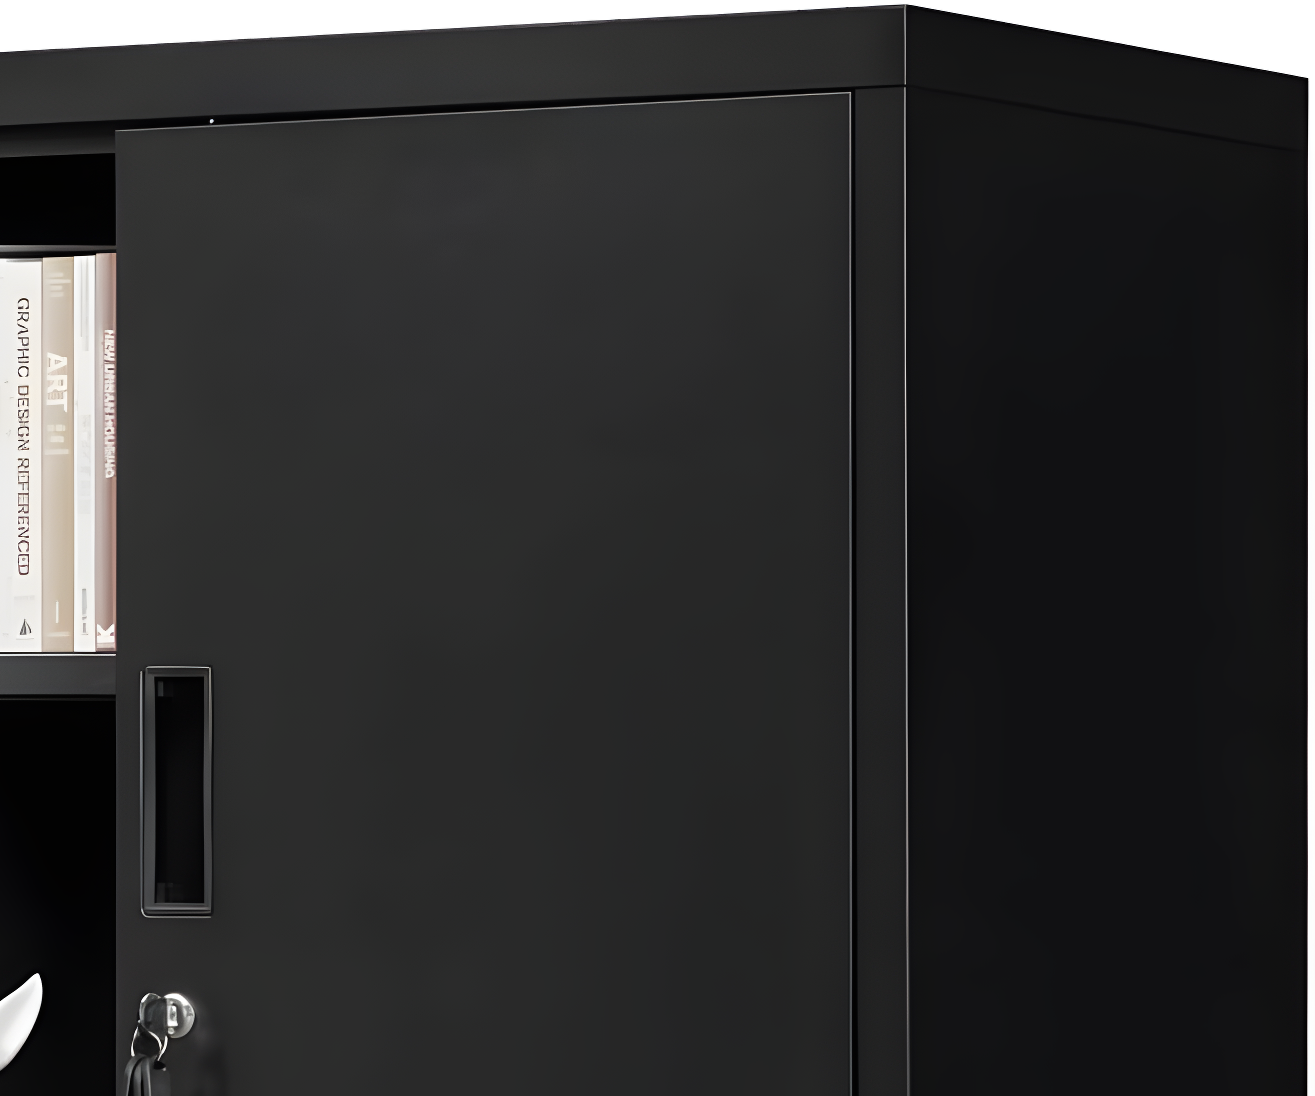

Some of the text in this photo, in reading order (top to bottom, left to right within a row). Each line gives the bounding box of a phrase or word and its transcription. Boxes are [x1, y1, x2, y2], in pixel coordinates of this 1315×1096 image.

[17, 297, 31, 577] GRAPHIC DESIGN REFERENCED
[46, 351, 68, 413] ART
